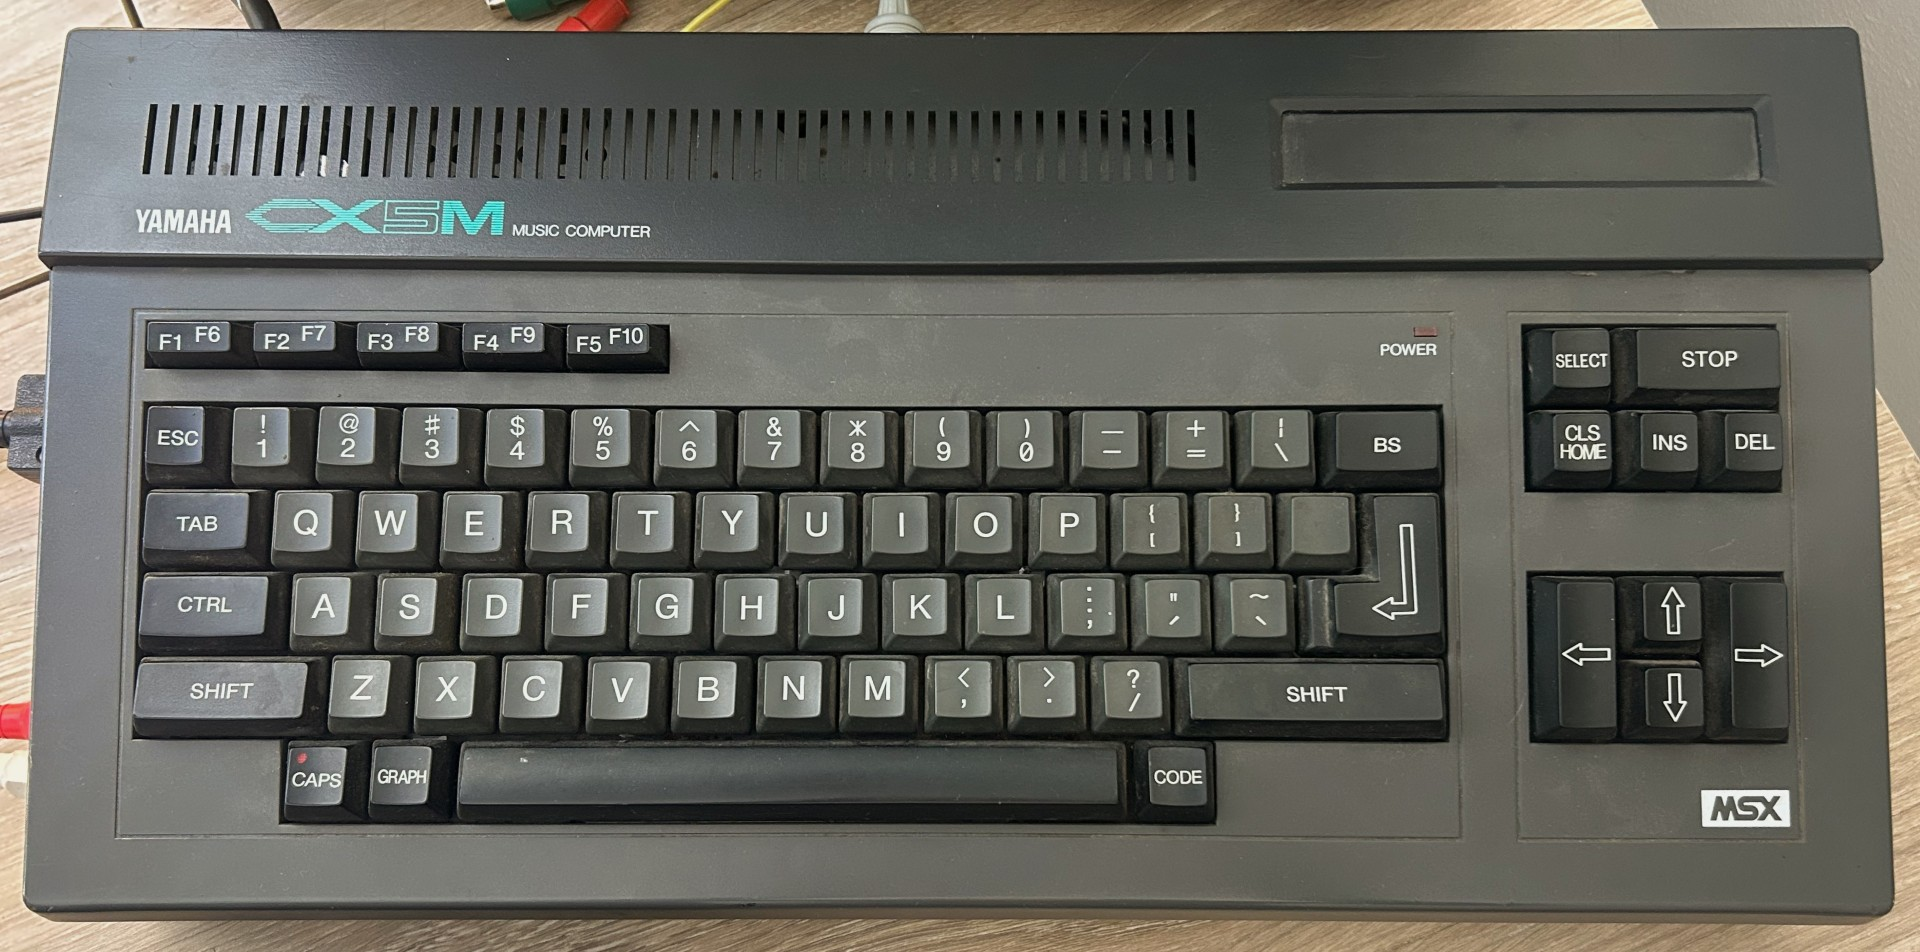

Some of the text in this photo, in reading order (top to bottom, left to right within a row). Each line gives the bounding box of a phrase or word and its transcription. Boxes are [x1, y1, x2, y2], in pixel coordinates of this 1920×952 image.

[136, 198, 505, 236] YAMAHA CX5M
[513, 224, 650, 237] MUSIC COMPUTER
[160, 326, 220, 350] F1 F6
[265, 325, 326, 349] F2 F7
[368, 326, 429, 350] F3 F8
[474, 327, 535, 350] F4 F9
[577, 328, 643, 352] F5 F10
[1381, 343, 1436, 356] POWER
[1682, 351, 1737, 367] STOP
[1556, 354, 1608, 368] SELECT
[339, 413, 359, 434] @
[425, 414, 440, 435] #
[510, 415, 525, 437] $
[593, 416, 613, 436] %
[767, 417, 782, 436] &
[938, 416, 946, 438] (
[1023, 418, 1031, 439] )
[1187, 420, 1205, 437] +
[1565, 425, 1601, 441] CLS
[158, 430, 198, 446] ESC
[256, 438, 266, 458] 1
[341, 438, 355, 457] 2
[425, 439, 439, 458] 3
[1374, 438, 1401, 452] BS
[1653, 434, 1687, 451] INS
[1735, 434, 1775, 450] DEL
[510, 441, 525, 460] 4
[596, 441, 610, 460] 5
[682, 441, 696, 461] 6
[768, 442, 781, 460] 7
[851, 443, 865, 462] 8
[937, 442, 951, 461] 9
[1186, 449, 1206, 458] =
[1560, 443, 1607, 460] HOME
[177, 516, 217, 531] TAB
[294, 510, 318, 536] Q
[375, 510, 406, 535] W
[465, 511, 483, 535] E
[552, 510, 572, 534] R
[638, 511, 658, 535] T
[722, 510, 743, 535] Y
[806, 512, 827, 537] U
[974, 512, 998, 537] O
[1061, 513, 1079, 537] P
[178, 597, 232, 612] CTRL
[311, 594, 335, 618] A
[399, 594, 419, 619] S
[486, 595, 507, 619] D
[572, 594, 591, 619] F
[656, 594, 678, 619] G
[741, 596, 762, 620] H
[828, 595, 844, 620] J
[911, 595, 931, 619] K
[998, 595, 1014, 619] L
[350, 675, 373, 700] Z
[958, 668, 969, 687] <
[1044, 667, 1055, 687] >
[1127, 669, 1139, 688] ?
[190, 683, 254, 699] SHIFT
[436, 677, 458, 701] X
[523, 676, 545, 701] C
[612, 678, 633, 702] V
[698, 677, 719, 701] B
[783, 676, 804, 700] N
[865, 676, 890, 700] M
[1287, 686, 1347, 702] SHIFT
[1129, 693, 1140, 712] /
[292, 772, 341, 788] CAPS
[378, 769, 427, 784] GRAPH
[1154, 770, 1203, 784] CODE
[1710, 796, 1782, 820] MSX
